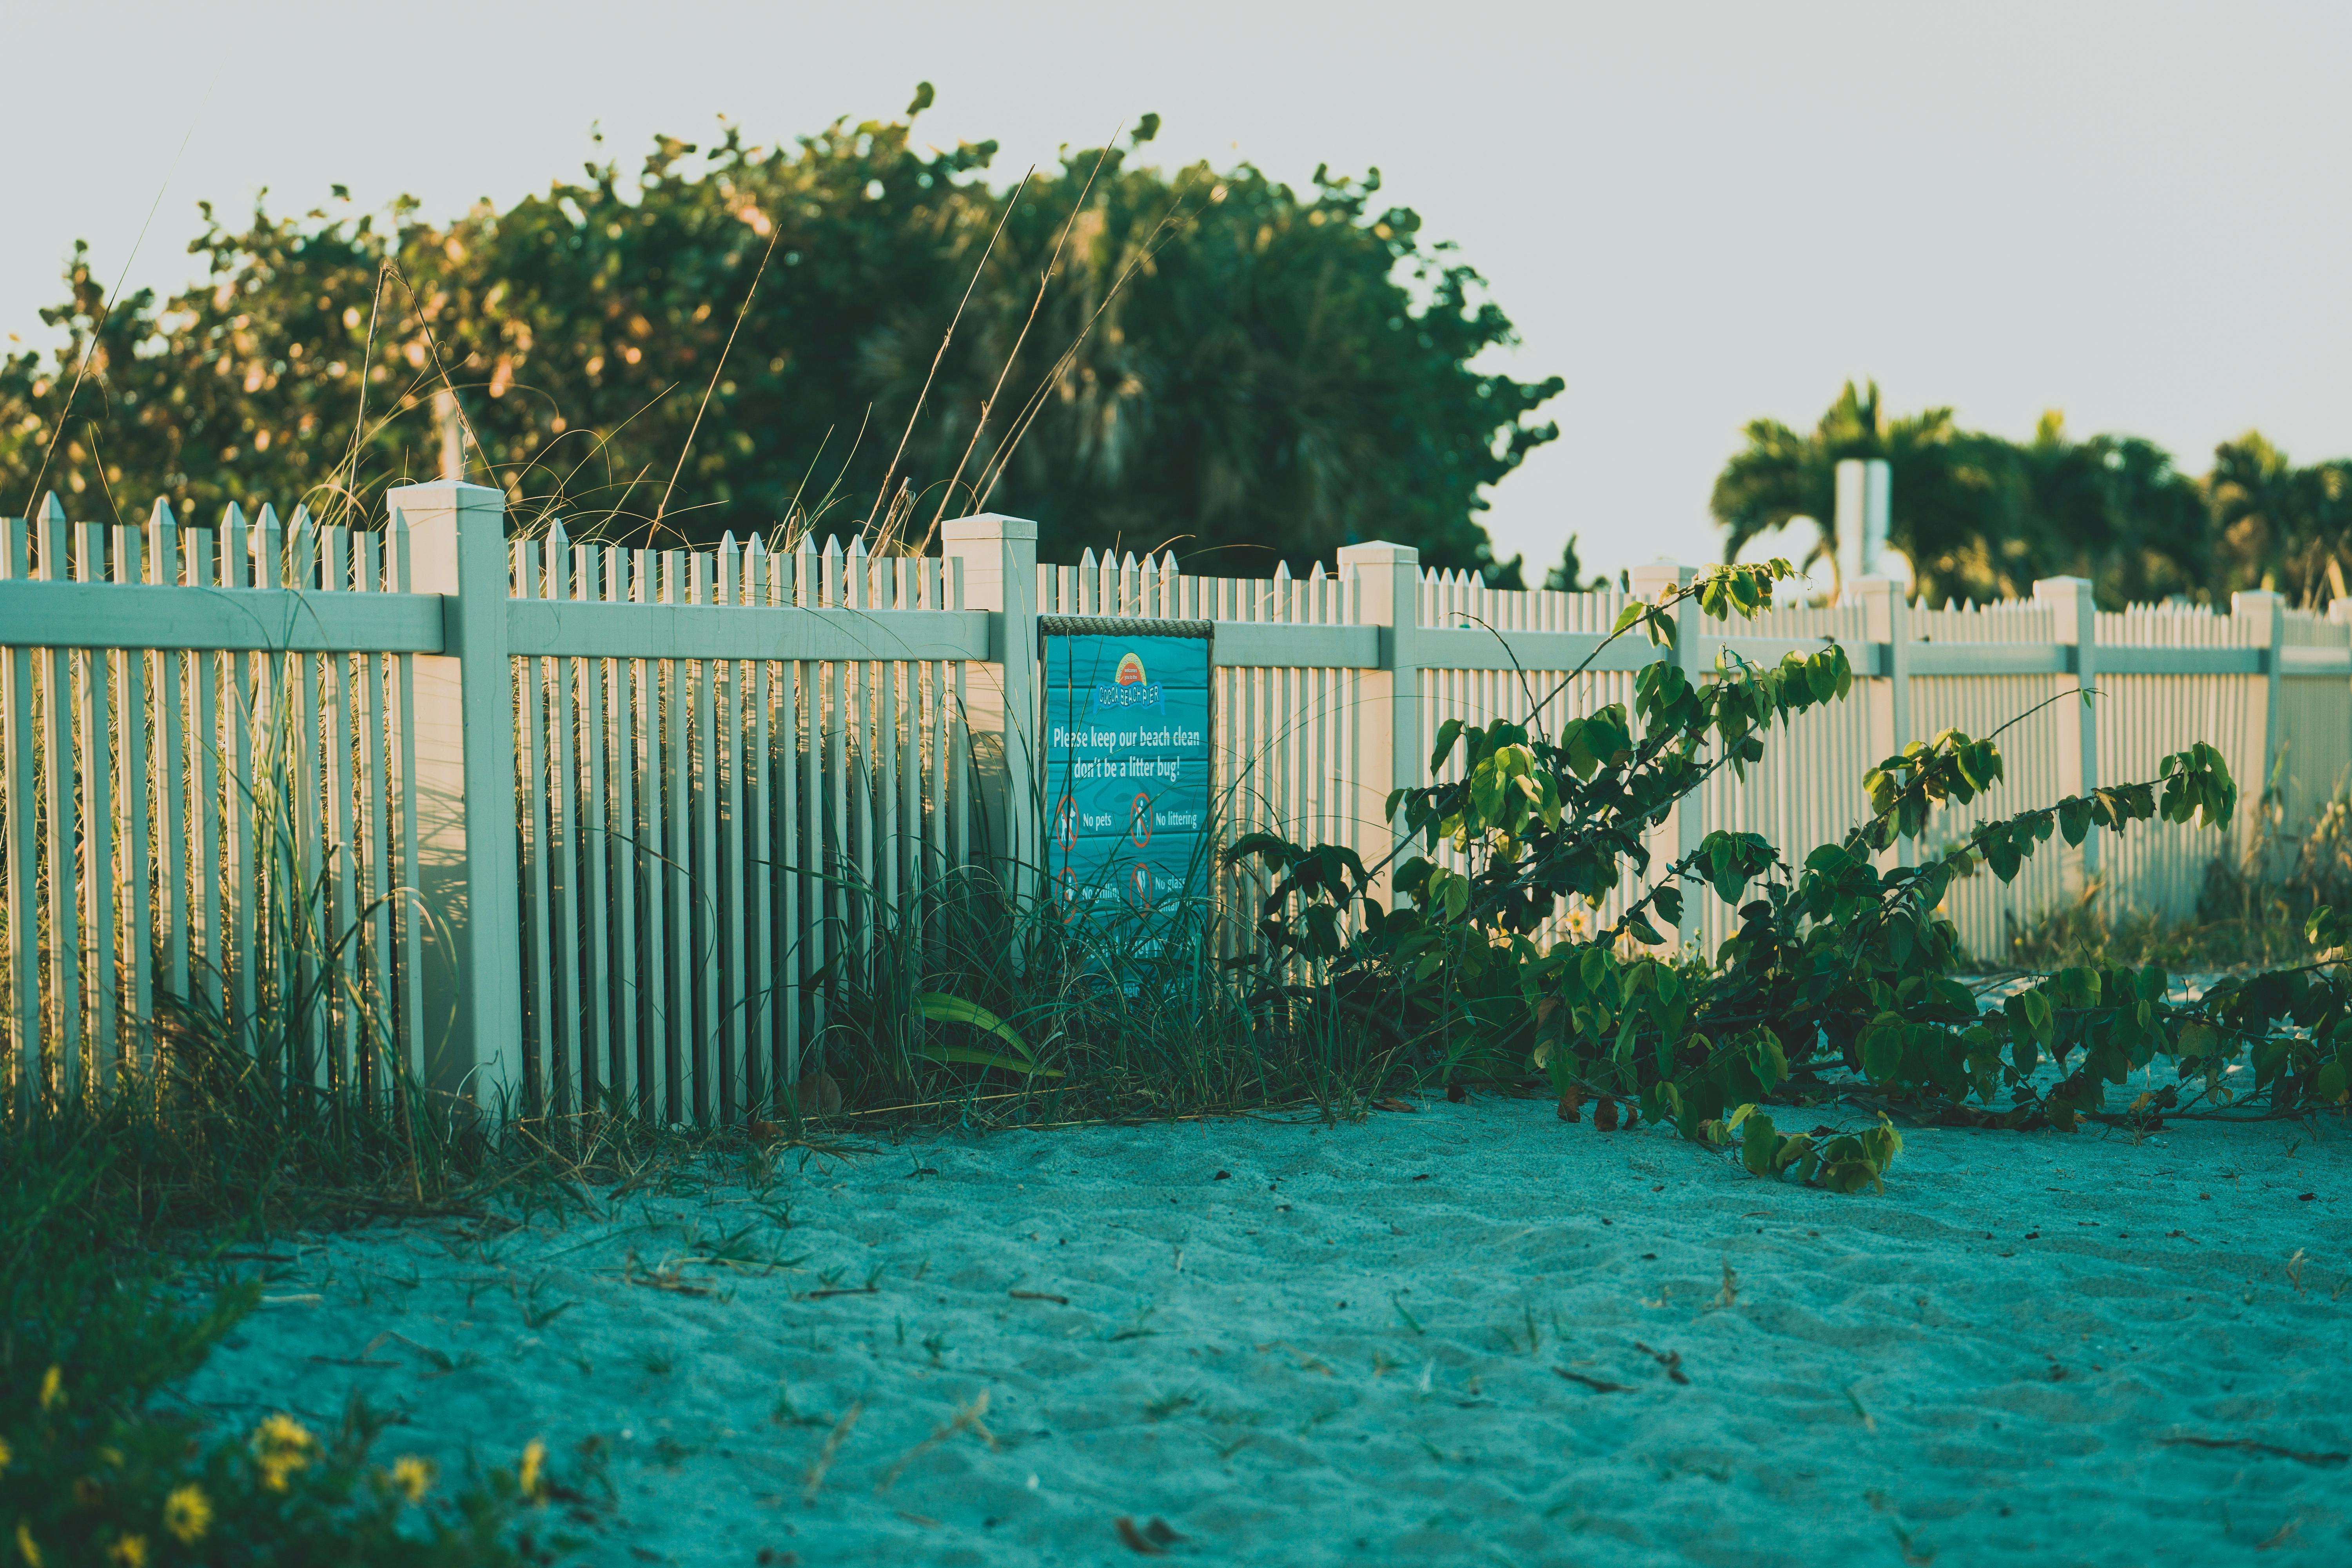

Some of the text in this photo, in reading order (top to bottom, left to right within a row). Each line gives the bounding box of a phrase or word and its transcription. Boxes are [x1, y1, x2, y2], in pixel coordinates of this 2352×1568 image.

[1100, 684, 1159, 706] COCOA BEACH PIER
[1054, 725, 1200, 753] Please keep our beach clean
[1074, 755, 1180, 782] don't be a litter bug!
[1083, 812, 1112, 831] No pets
[1156, 811, 1197, 829] No littering
[1155, 876, 1165, 890] No
[1082, 886, 1093, 900] No
